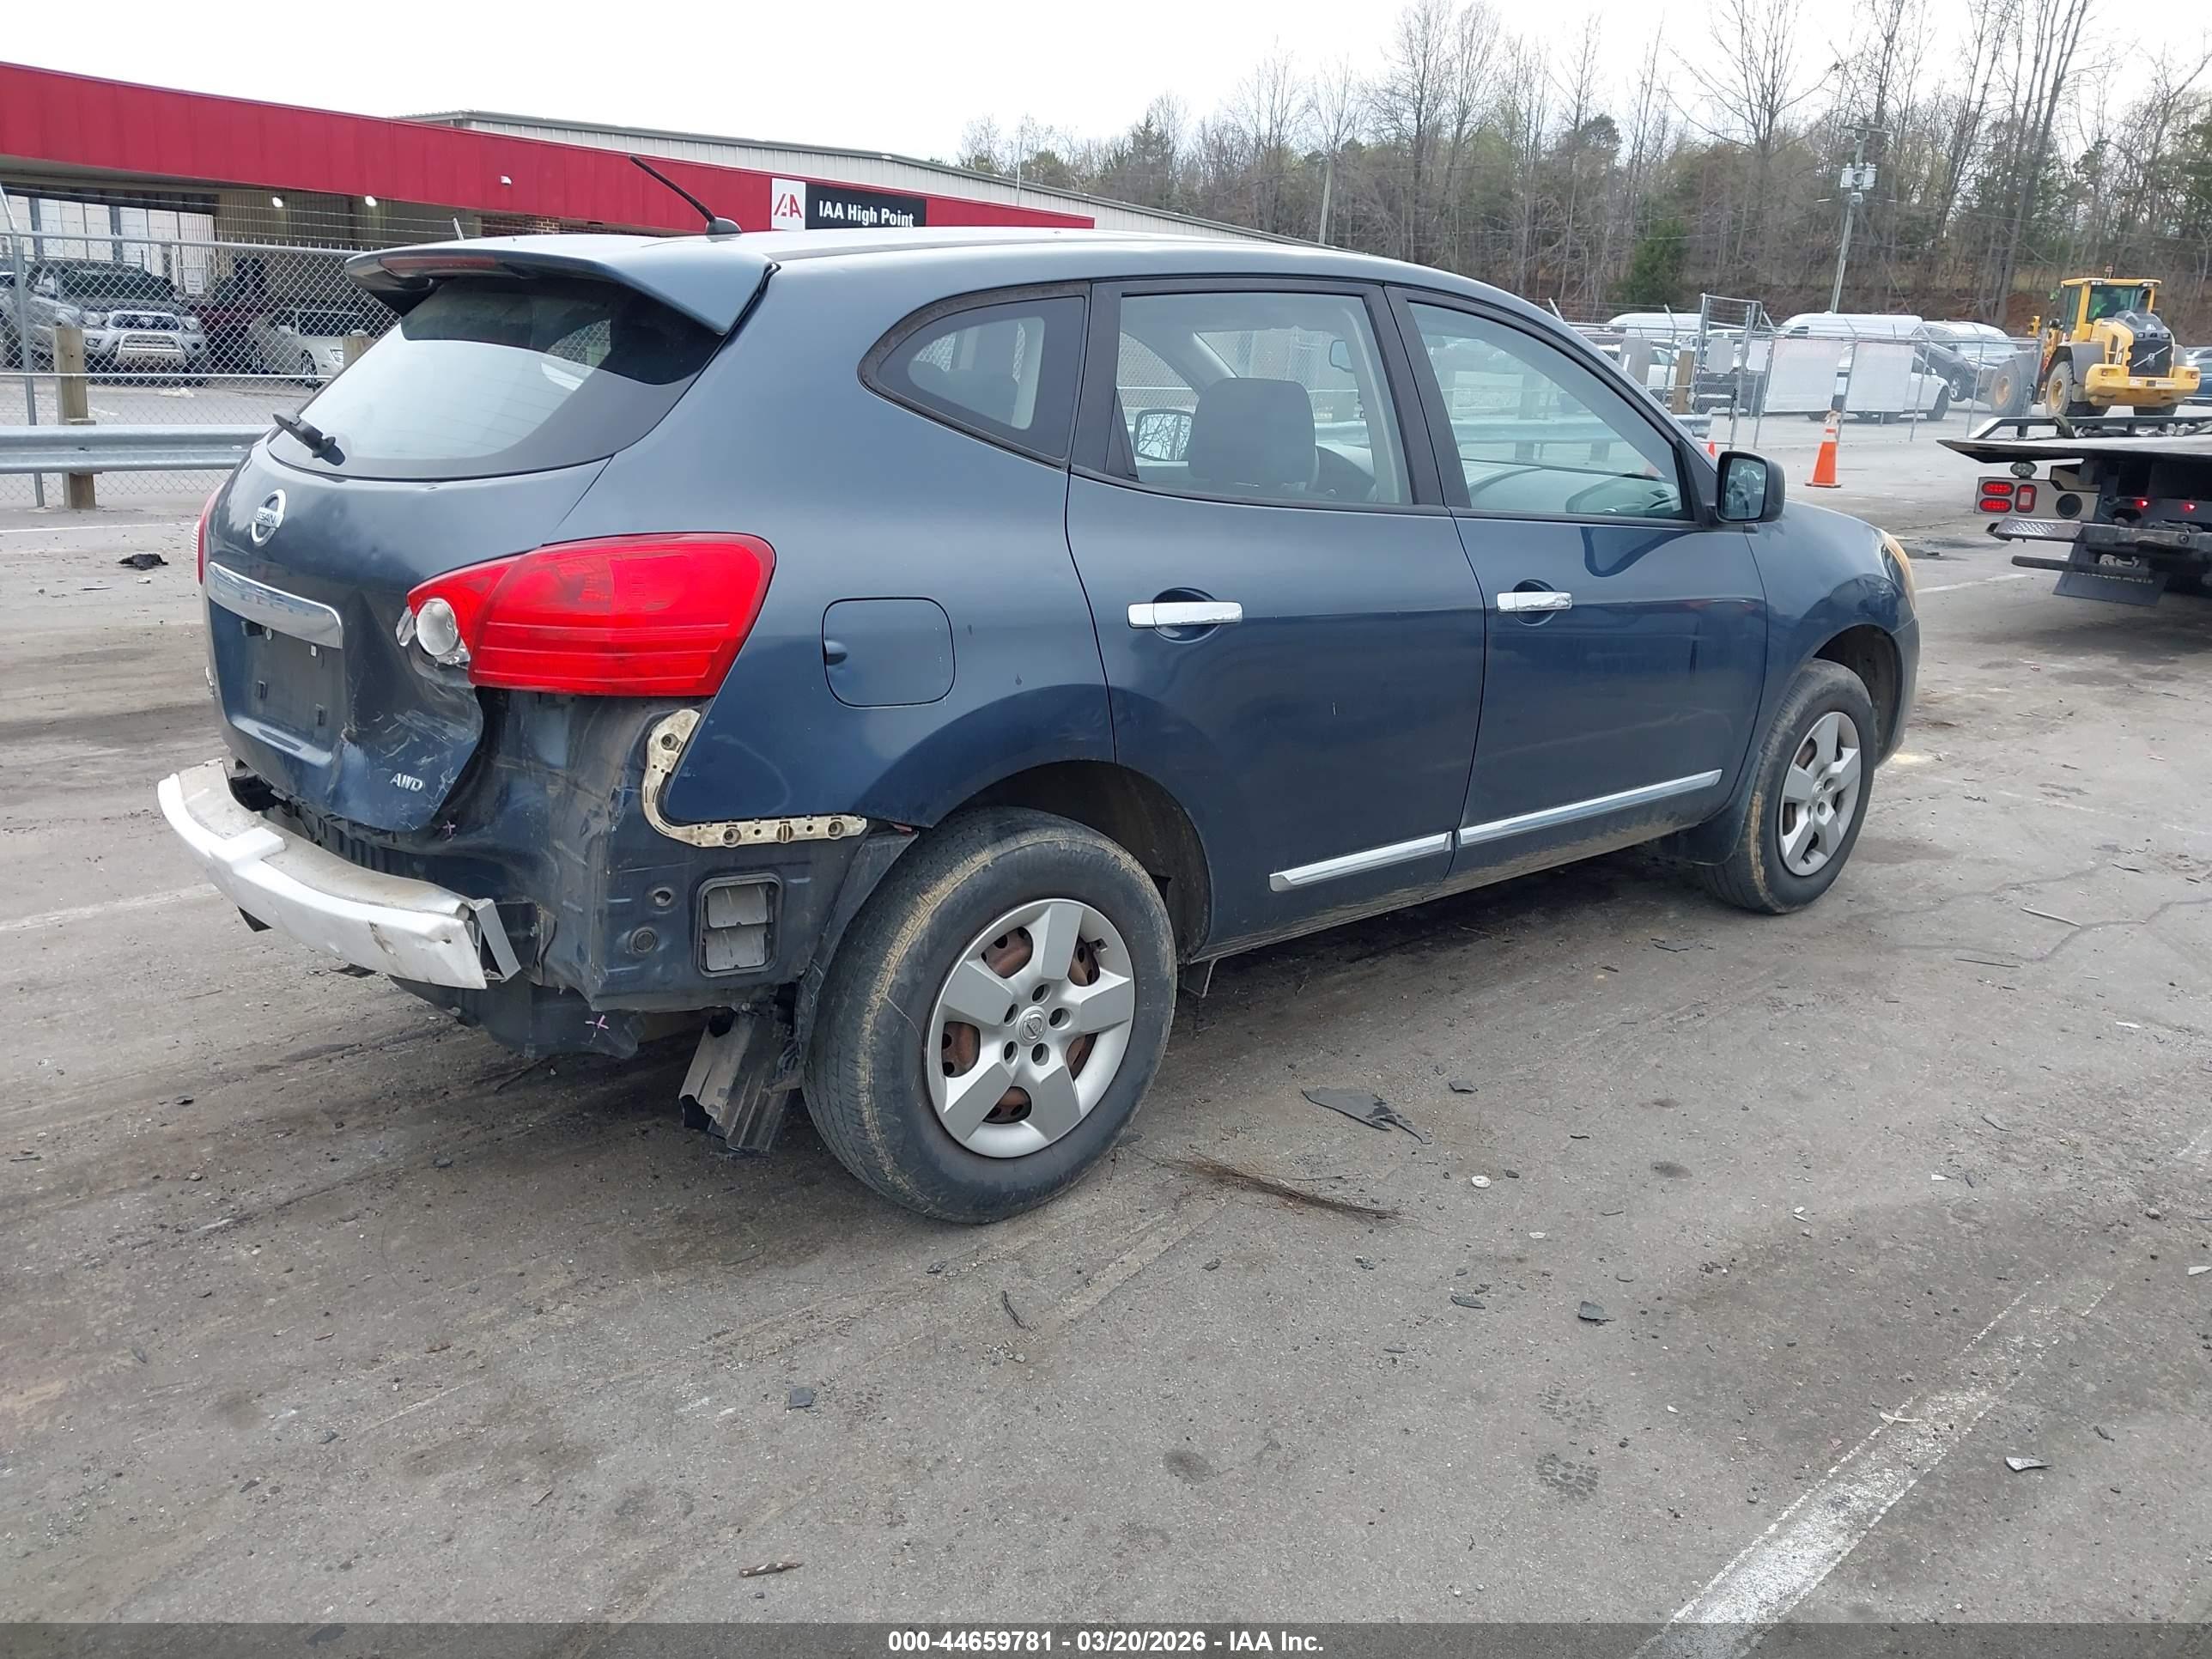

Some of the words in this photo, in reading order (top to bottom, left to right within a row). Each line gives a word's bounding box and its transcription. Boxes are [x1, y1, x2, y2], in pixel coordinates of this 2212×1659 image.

[818, 199, 845, 220] IAA
[848, 204, 878, 227] High
[881, 207, 915, 228] Point
[389, 772, 424, 793] AWD
